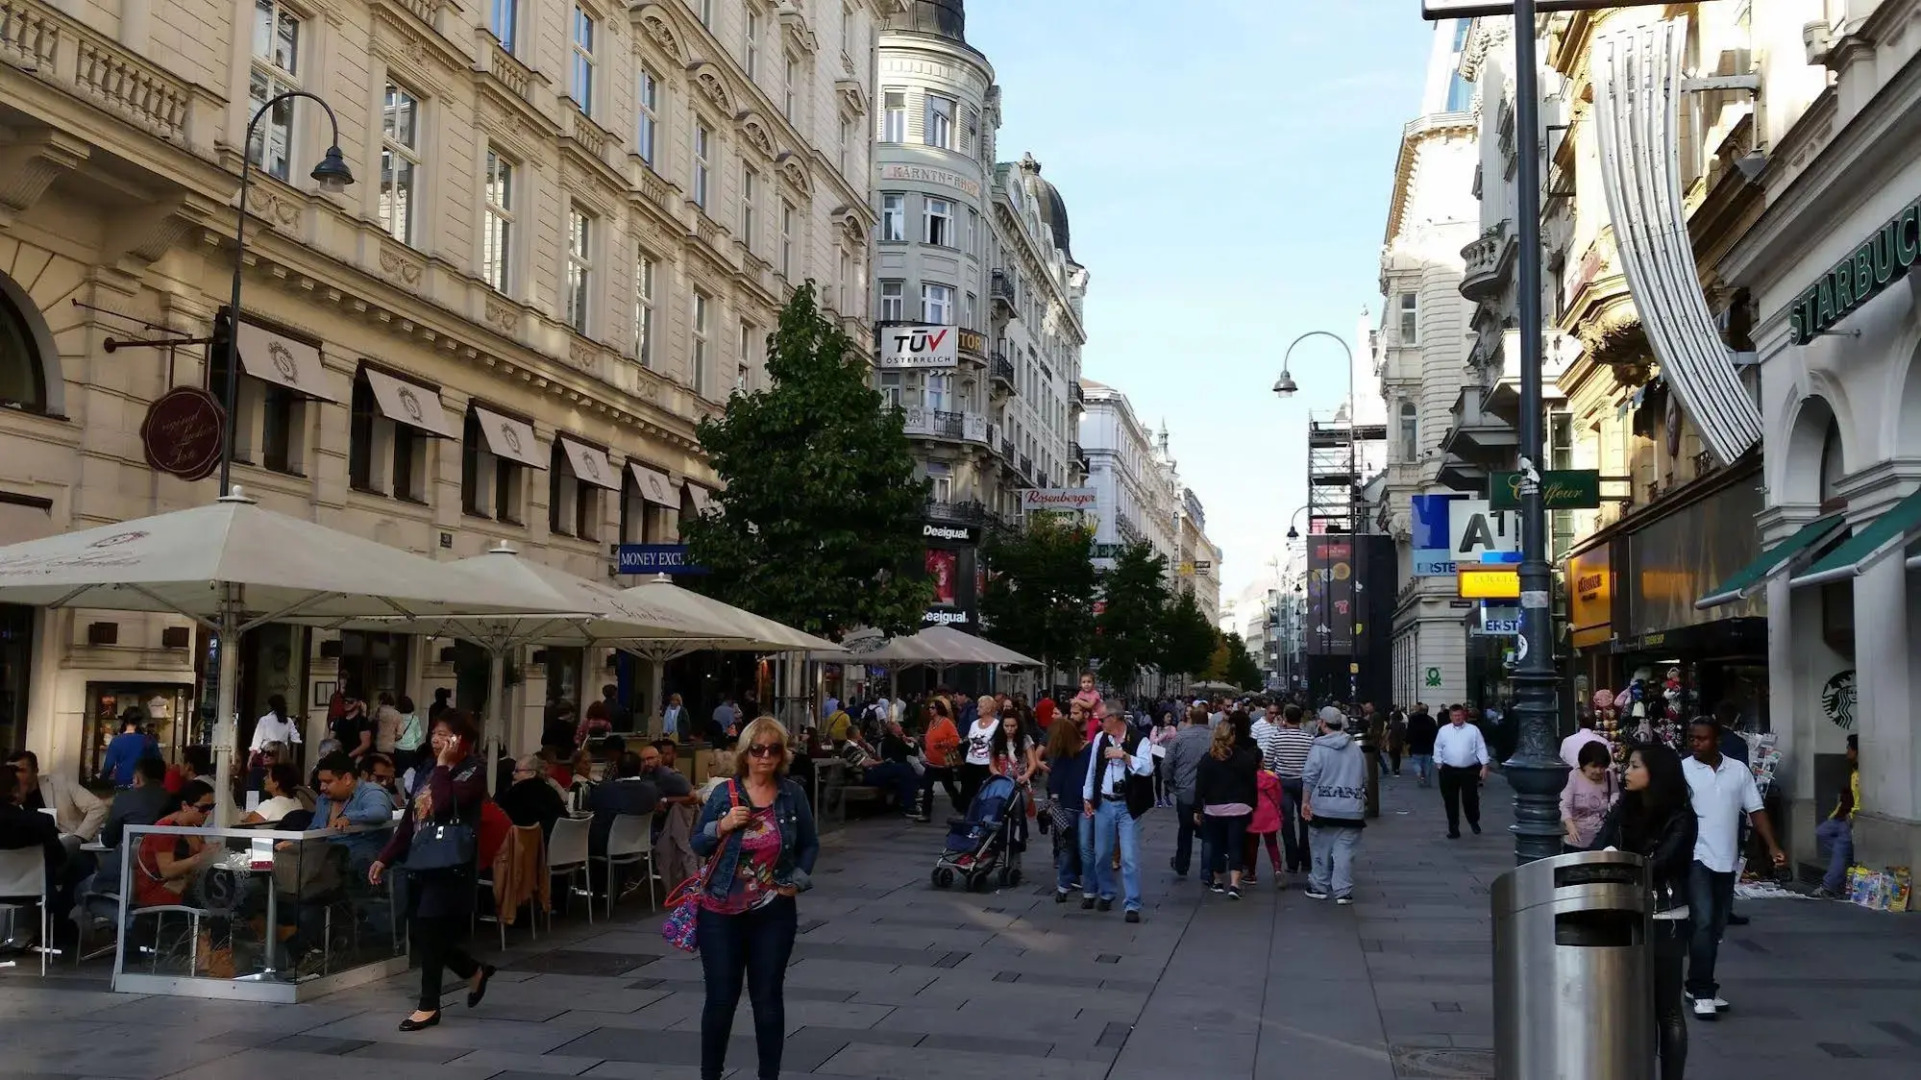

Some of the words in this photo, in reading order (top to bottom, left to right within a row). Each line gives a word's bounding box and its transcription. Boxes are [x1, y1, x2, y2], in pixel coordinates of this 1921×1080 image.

[1790, 200, 1921, 346] STARBUC
[886, 356, 951, 364] ÖSTERREICH
[1025, 489, 1096, 508] Rosenberger
[621, 552, 656, 566] MONEY
[1417, 562, 1457, 574] ERSTE
